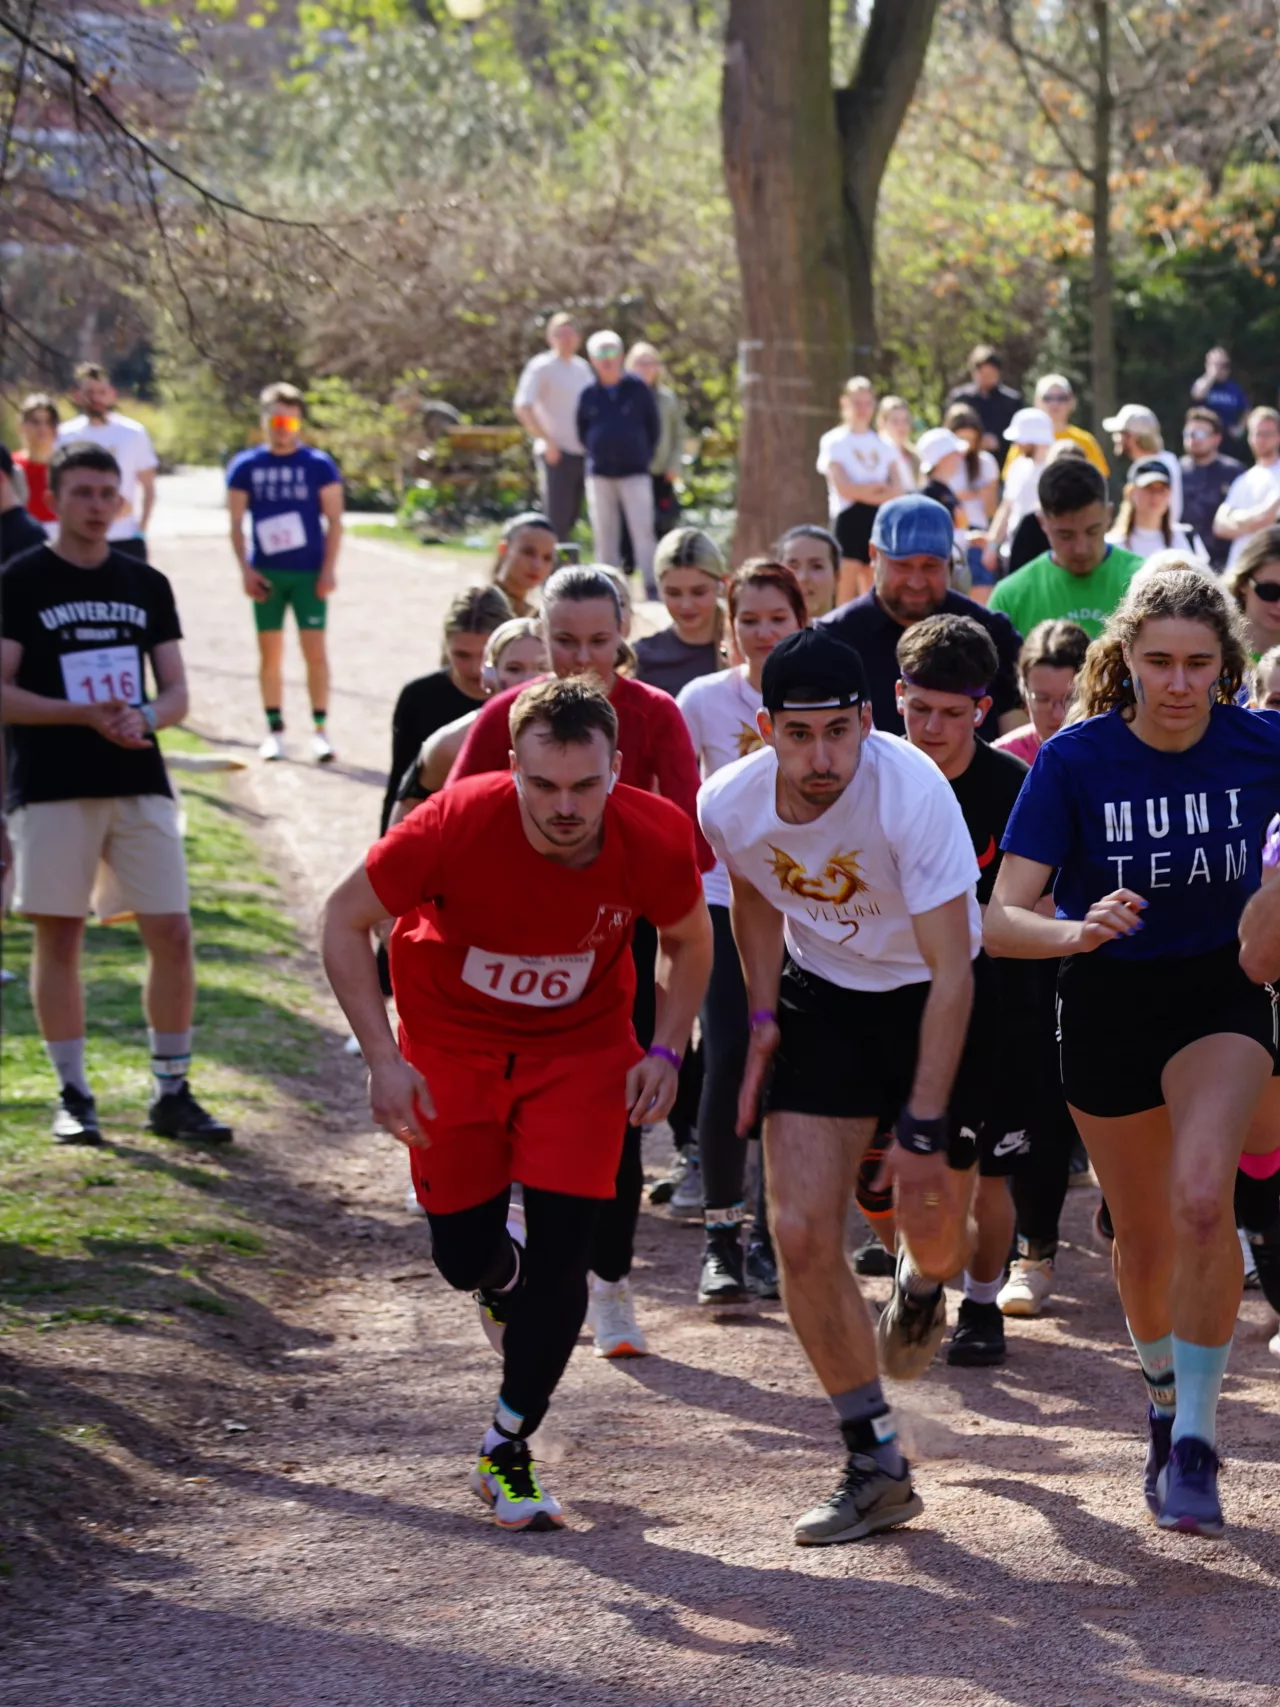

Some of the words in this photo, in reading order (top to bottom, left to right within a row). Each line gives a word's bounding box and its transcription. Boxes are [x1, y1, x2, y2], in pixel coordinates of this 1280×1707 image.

[79, 671, 136, 703] 116
[1104, 788, 1242, 842] MUNI
[1107, 839, 1247, 889] TEAM
[484, 961, 571, 1000] 106
